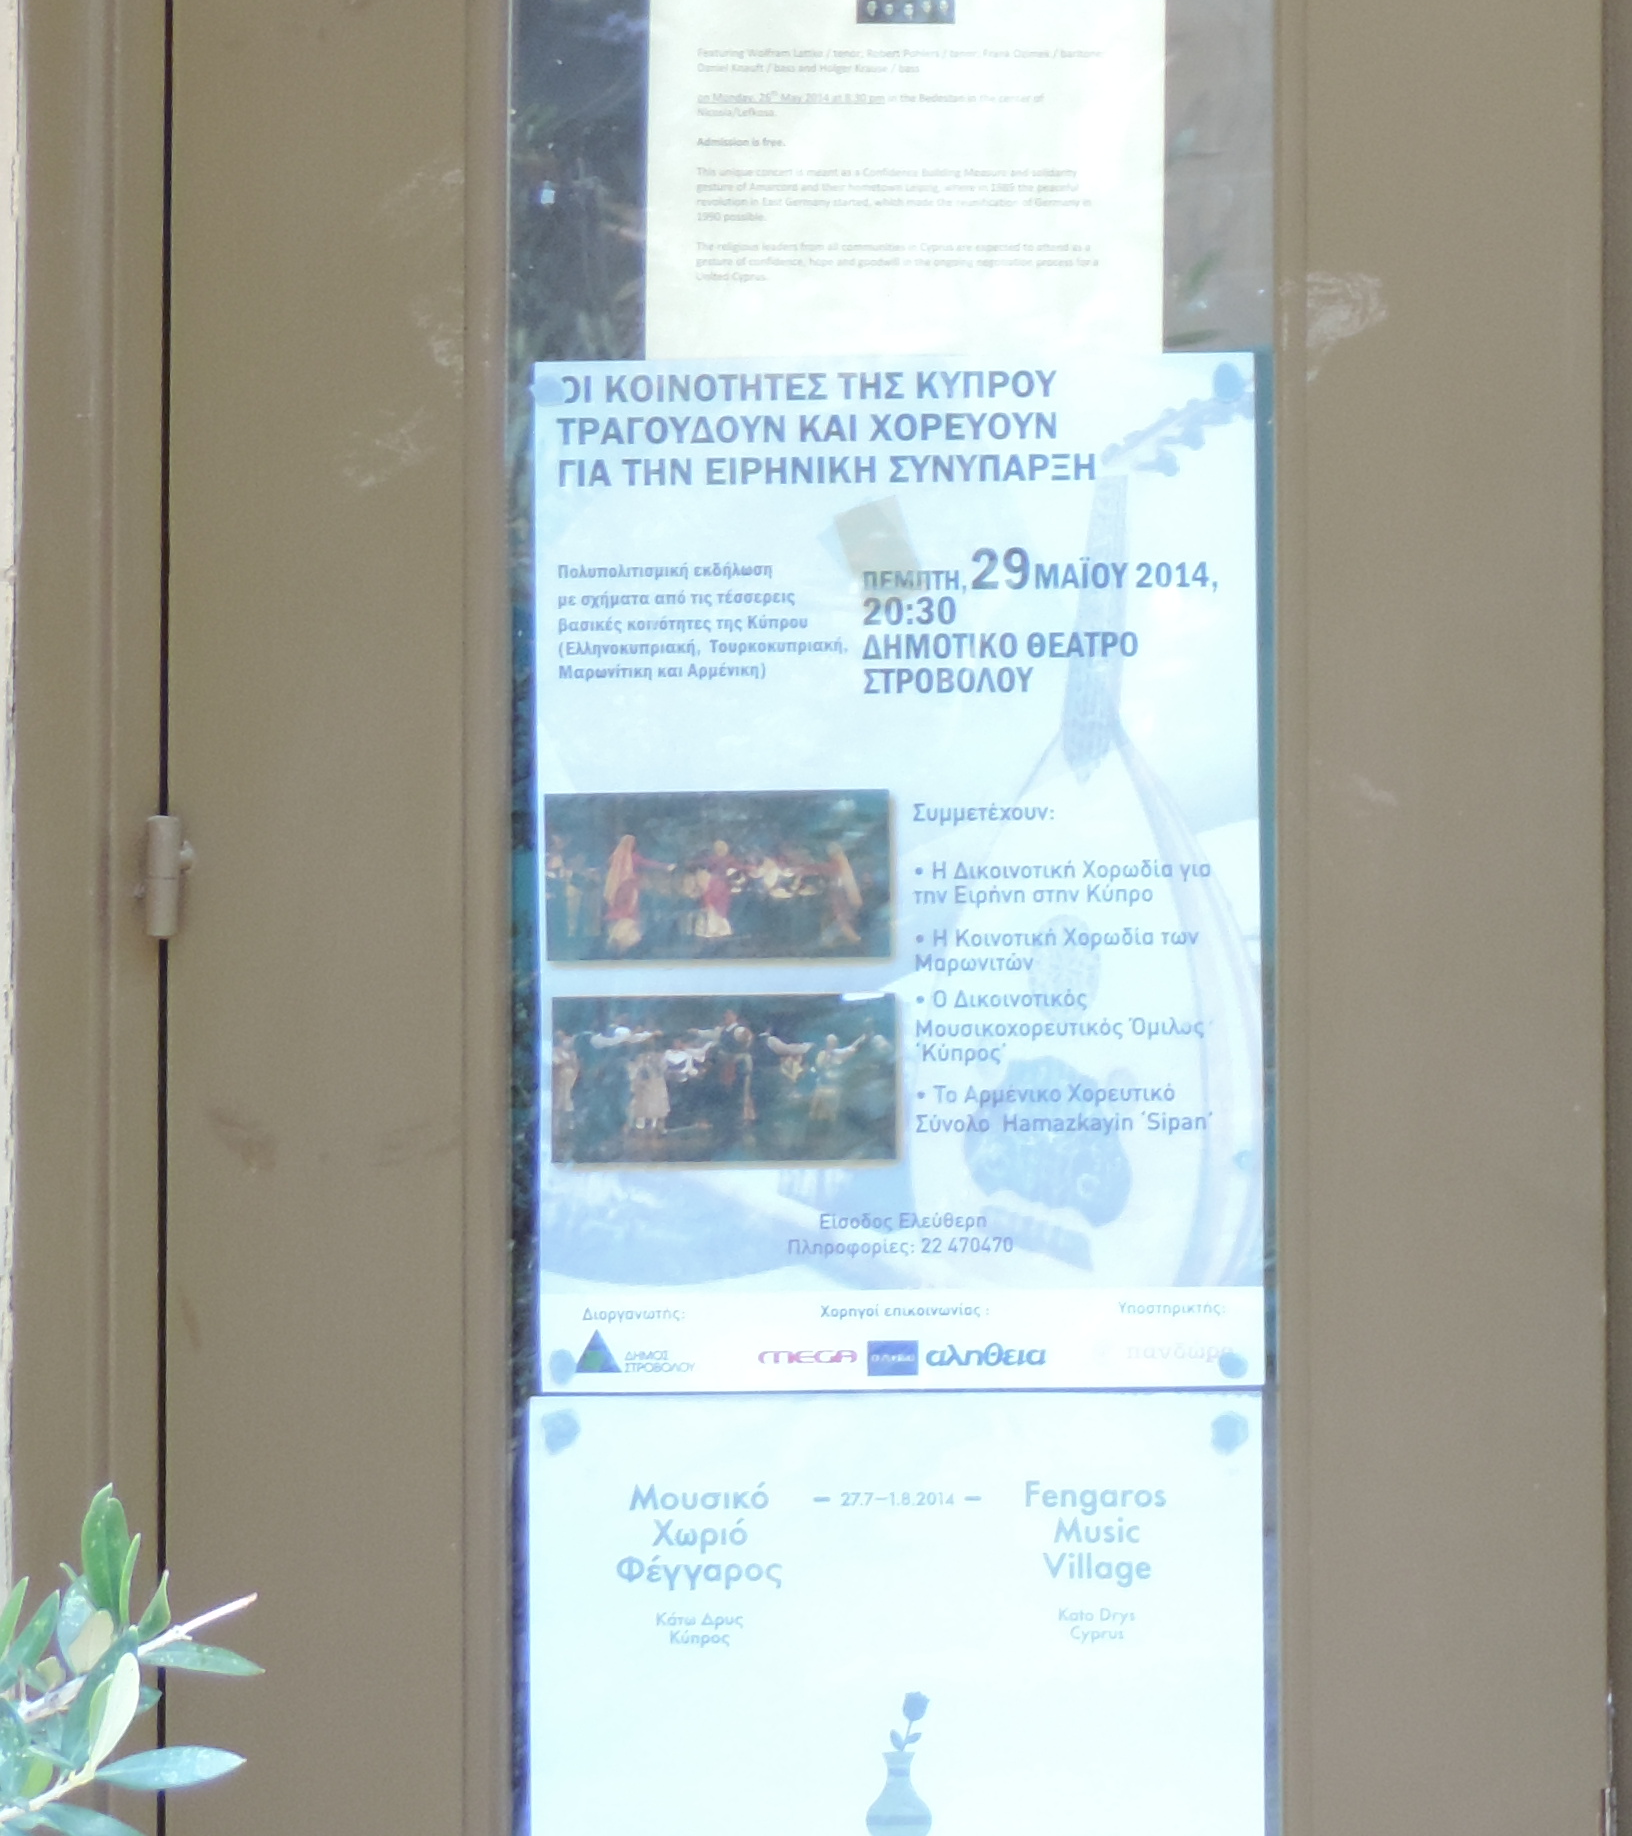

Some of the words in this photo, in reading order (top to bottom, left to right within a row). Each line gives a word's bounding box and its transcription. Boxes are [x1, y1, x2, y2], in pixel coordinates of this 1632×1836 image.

[697, 138, 749, 147] Admission
[752, 138, 760, 147] is
[763, 138, 785, 147] free.
[606, 372, 828, 402] ΚΟΙΝΟΤΗΤΕΣ
[838, 372, 905, 400] ΤΗΣ
[917, 371, 1056, 399] ΚΥΠΡΟΥ
[557, 414, 784, 445] ΤΡΑΓΟΥΔΟΥΝ
[801, 413, 858, 442] ΚΑΙ
[869, 412, 1057, 441] ΧΟΡΕΥΟΥΝ
[558, 459, 610, 487] ΓΙΑ
[622, 458, 692, 486] ΤΗΝ
[706, 456, 876, 485] ΕΙΡΗΝΙΚΗ
[889, 453, 1095, 482] ΣΥΝΥΠΑΡΞΗ
[558, 563, 688, 579] Πολυπολιτισμική
[694, 562, 772, 578] εκδήλωση
[862, 570, 967, 593] ΠΕΜΠΤΗ,
[971, 547, 1030, 590] 29
[1035, 556, 1128, 589] ΜΑΪΟΥ
[1136, 562, 1218, 592] 2014,
[558, 596, 576, 608] με
[581, 593, 650, 608] σχήματα
[655, 592, 685, 605] από
[692, 593, 712, 606] τις
[718, 591, 795, 607] τέσσερεις
[862, 597, 956, 625] 20:30
[559, 618, 622, 634] βασικές
[628, 617, 711, 632] κοινότητες
[717, 618, 742, 632] της
[748, 615, 807, 631] Κύπρου
[862, 633, 1018, 659] ΔΗΜΟΤΙΚΟ
[1027, 632, 1138, 658] ΘΕΑΤΡΟ
[658, 666, 682, 678] και
[863, 667, 1033, 694] ΣΤΡΟΒΟΛΟΥ
[913, 803, 1054, 826] Συμμετέχουν:
[933, 862, 946, 879] Η
[954, 861, 1075, 879] Δικοινοτική
[1083, 859, 1172, 881] Χορωδία
[1180, 863, 1210, 881] για
[913, 889, 947, 904] την
[955, 886, 1025, 908] Ειρήνη
[1033, 889, 1079, 904] στην
[1087, 884, 1153, 906] Κύπρο
[934, 929, 947, 946] Η
[956, 929, 1056, 947] Κοινοτική
[1063, 928, 1153, 950] Χορωδία
[1161, 931, 1199, 945] των
[916, 953, 1033, 975] Μαρωνιτών
[934, 990, 947, 1007] Ο
[954, 989, 1087, 1010] Δικοινοτικός
[916, 1020, 1123, 1041] Μουσικοχορευτικός
[934, 1085, 957, 1103] Το
[964, 1084, 1061, 1106] Αρμένικο
[1068, 1083, 1175, 1105] Χορευτικό
[916, 1115, 989, 1133] Σύνολο
[1003, 1113, 1133, 1135] Hamazkayin
[820, 1213, 892, 1231] Είσοδος
[900, 1212, 987, 1230] Ελεύθερη
[788, 1239, 915, 1257] Πληροφορίες:
[921, 1238, 942, 1253] 22
[948, 1237, 1013, 1253] 470470
[583, 1308, 685, 1322] Διοργανωτής:
[821, 1304, 879, 1319] Χορηγοί
[884, 1303, 980, 1317] επικοινωνίας
[625, 1350, 668, 1361] ΔΗΜΟΣ
[758, 1350, 857, 1363] MEGA
[625, 1362, 696, 1372] ΣΤΡΟΒΟΛΟΥ
[629, 1482, 769, 1510] Μουσικό
[1025, 1481, 1166, 1515] Fengaros
[653, 1518, 747, 1553] Χωριό
[1054, 1517, 1140, 1543] Music
[617, 1556, 783, 1589] Φέγγαρος
[1042, 1553, 1151, 1588] Village
[656, 1612, 696, 1626] Κάτω
[701, 1612, 743, 1629] Δρυς
[1058, 1608, 1095, 1622] Kato
[1100, 1608, 1135, 1624] Drys
[670, 1630, 730, 1647] Κύπρος
[1070, 1626, 1124, 1643] Cyprus
